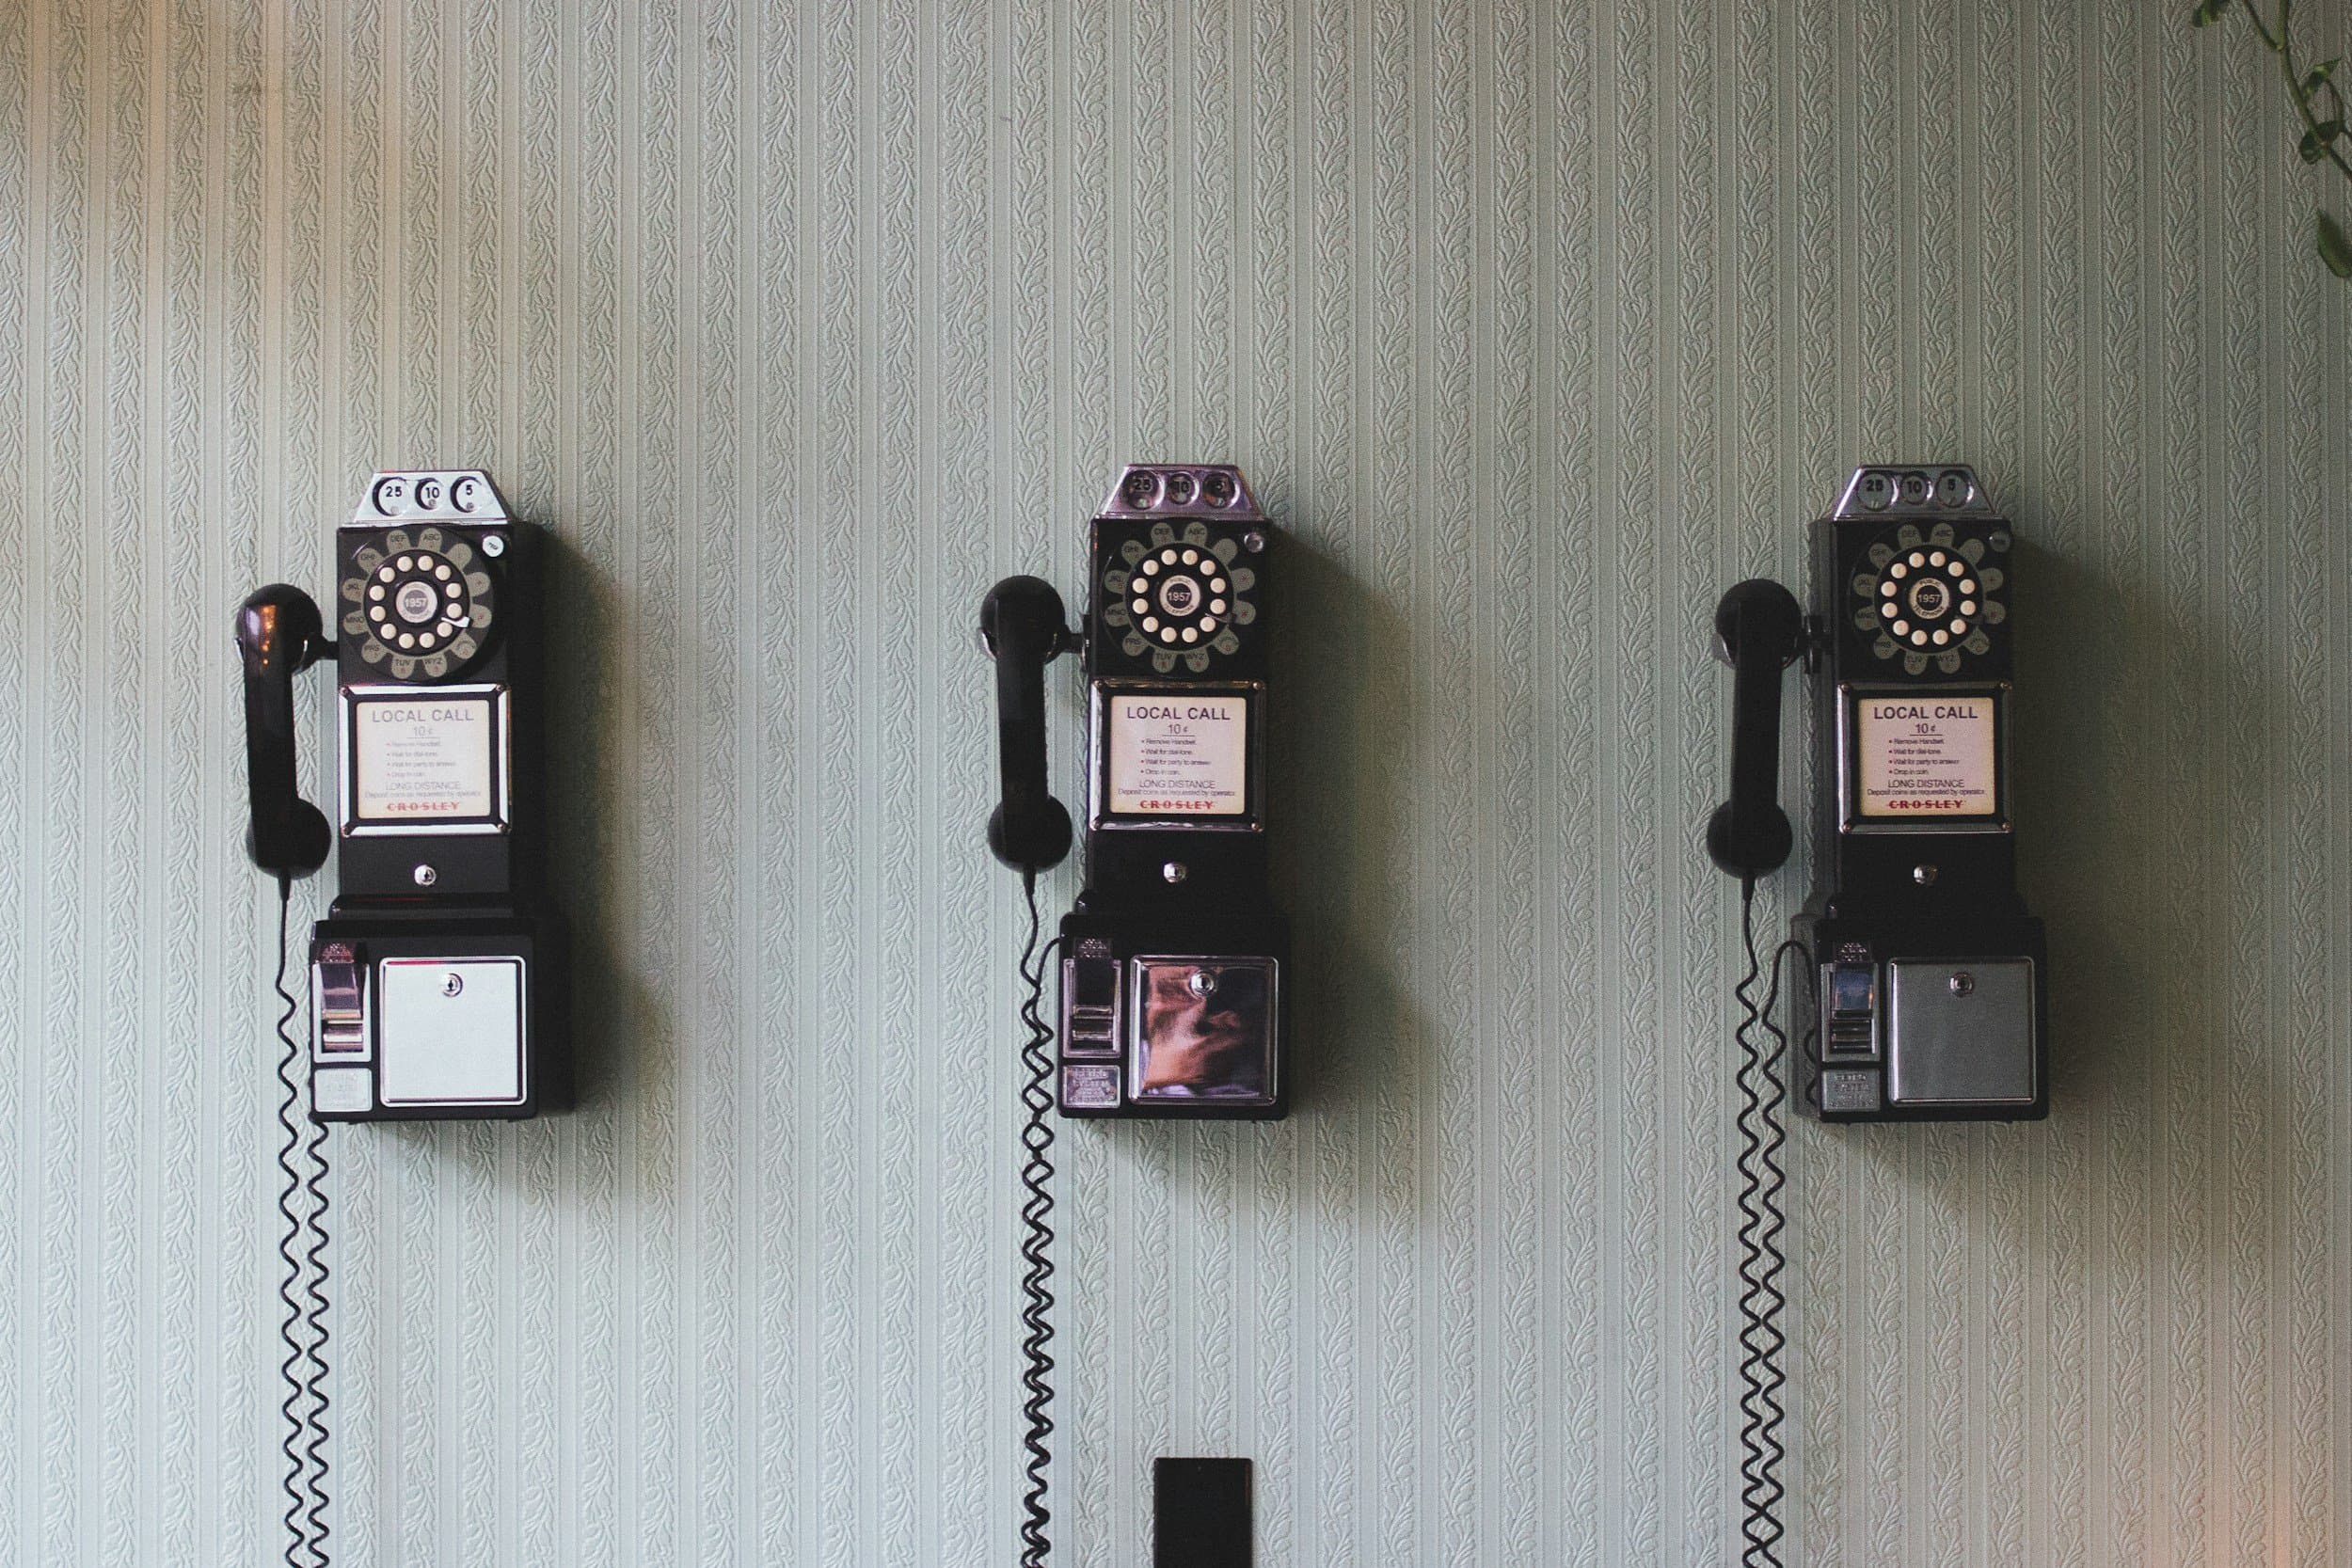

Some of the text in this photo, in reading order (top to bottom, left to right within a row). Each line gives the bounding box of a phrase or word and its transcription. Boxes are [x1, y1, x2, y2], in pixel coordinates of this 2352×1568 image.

[465, 484, 473, 496] 5
[1135, 479, 1152, 490] 25
[1176, 482, 1190, 492] 10
[1867, 480, 1883, 491] 25
[1907, 482, 1922, 493] 10
[386, 486, 403, 498] 25
[425, 487, 439, 499] 10
[1168, 592, 1190, 601] 1957
[1917, 594, 1941, 603] 1957
[405, 597, 427, 608] 1957
[372, 708, 474, 722] LOCAL CALL
[1127, 706, 1231, 721] LOCAL CALL
[1873, 706, 1978, 720] LOCAL CALL
[386, 781, 460, 791] LONG DISTANCE
[1139, 780, 1216, 789] LONG DISTANCE
[1887, 780, 1964, 788] LONG DISTANCE
[386, 801, 460, 811] CROSLEY
[1138, 800, 1215, 810] CROSLEY
[1887, 800, 1963, 810] CROSLEY
